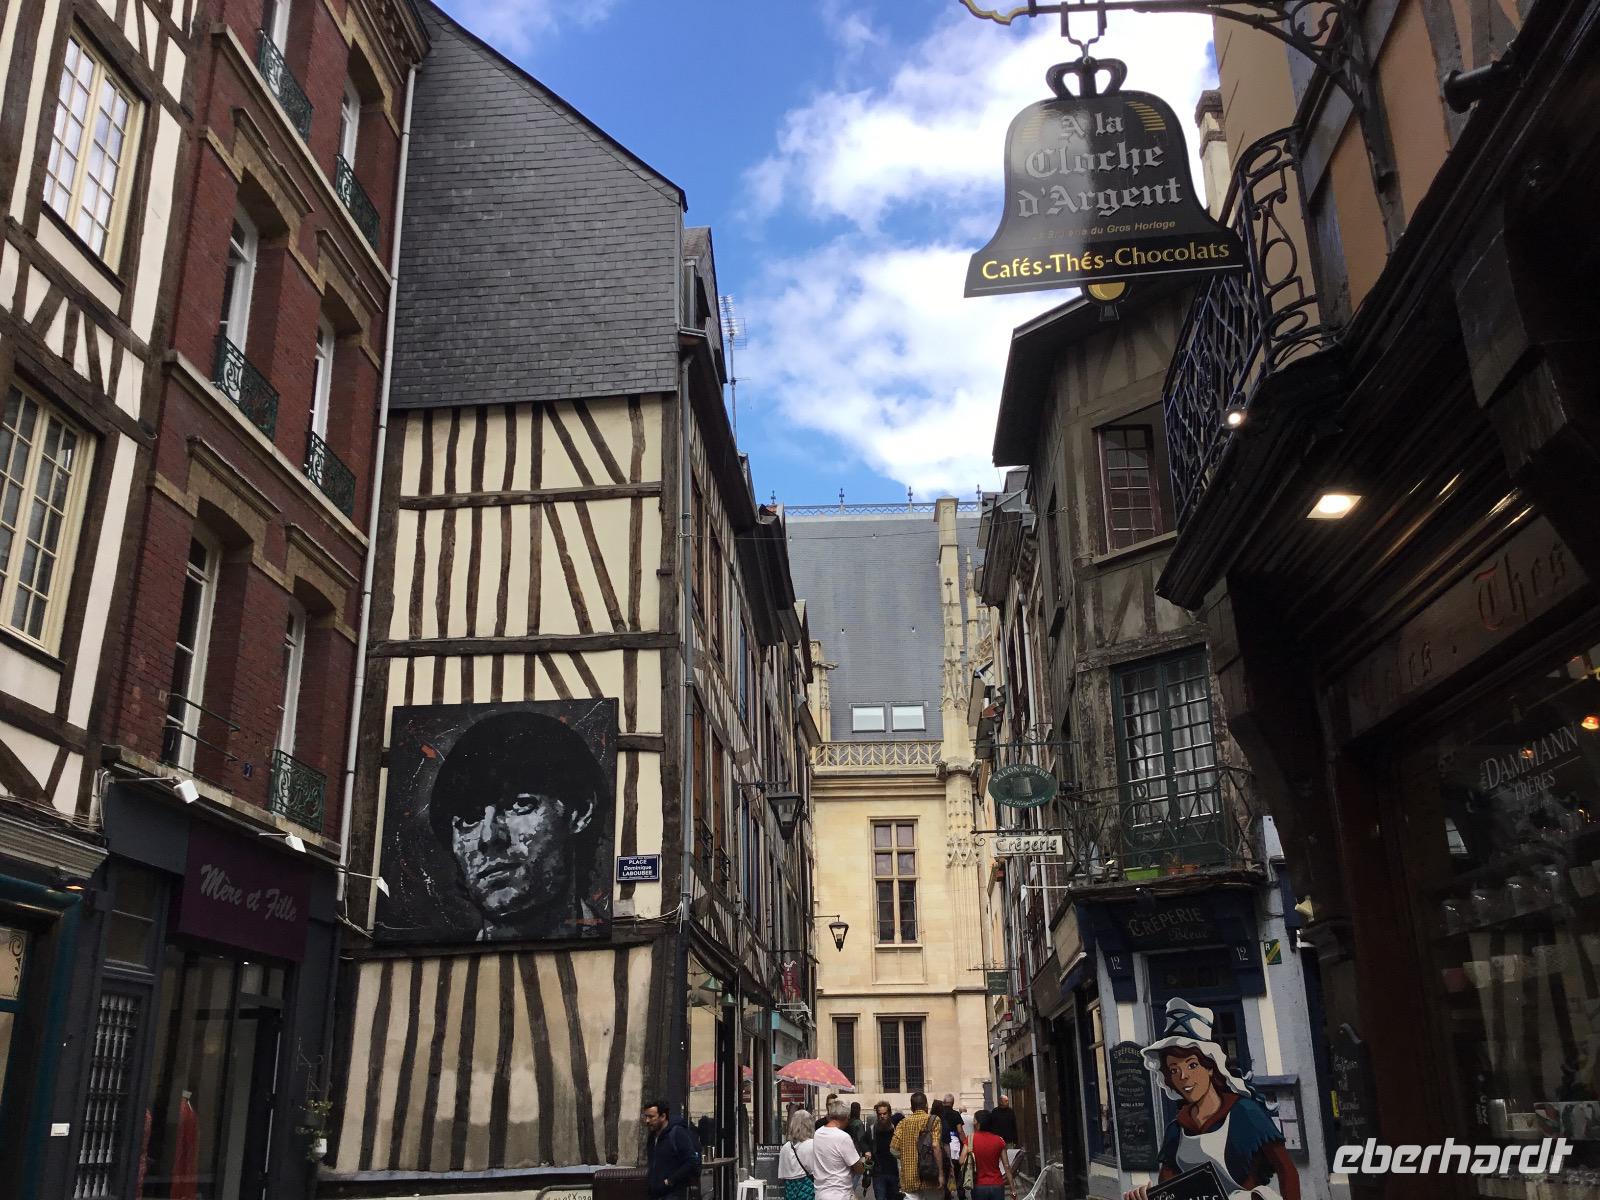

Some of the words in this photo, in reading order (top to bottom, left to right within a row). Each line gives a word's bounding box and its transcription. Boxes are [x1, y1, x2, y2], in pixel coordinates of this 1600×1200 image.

[1095, 112, 1125, 136] la
[1024, 140, 1166, 179] Cloche
[1017, 176, 1184, 218] d'Argent
[1090, 226, 1104, 235] du
[1106, 223, 1131, 233] Gros
[1134, 219, 1176, 231] Horloge
[1484, 722, 1580, 790] DAMMANN
[993, 766, 1018, 782] SALON
[200, 863, 242, 906] Mère
[246, 889, 261, 912] et
[1110, 955, 1122, 970] 12
[1236, 946, 1249, 961] 12
